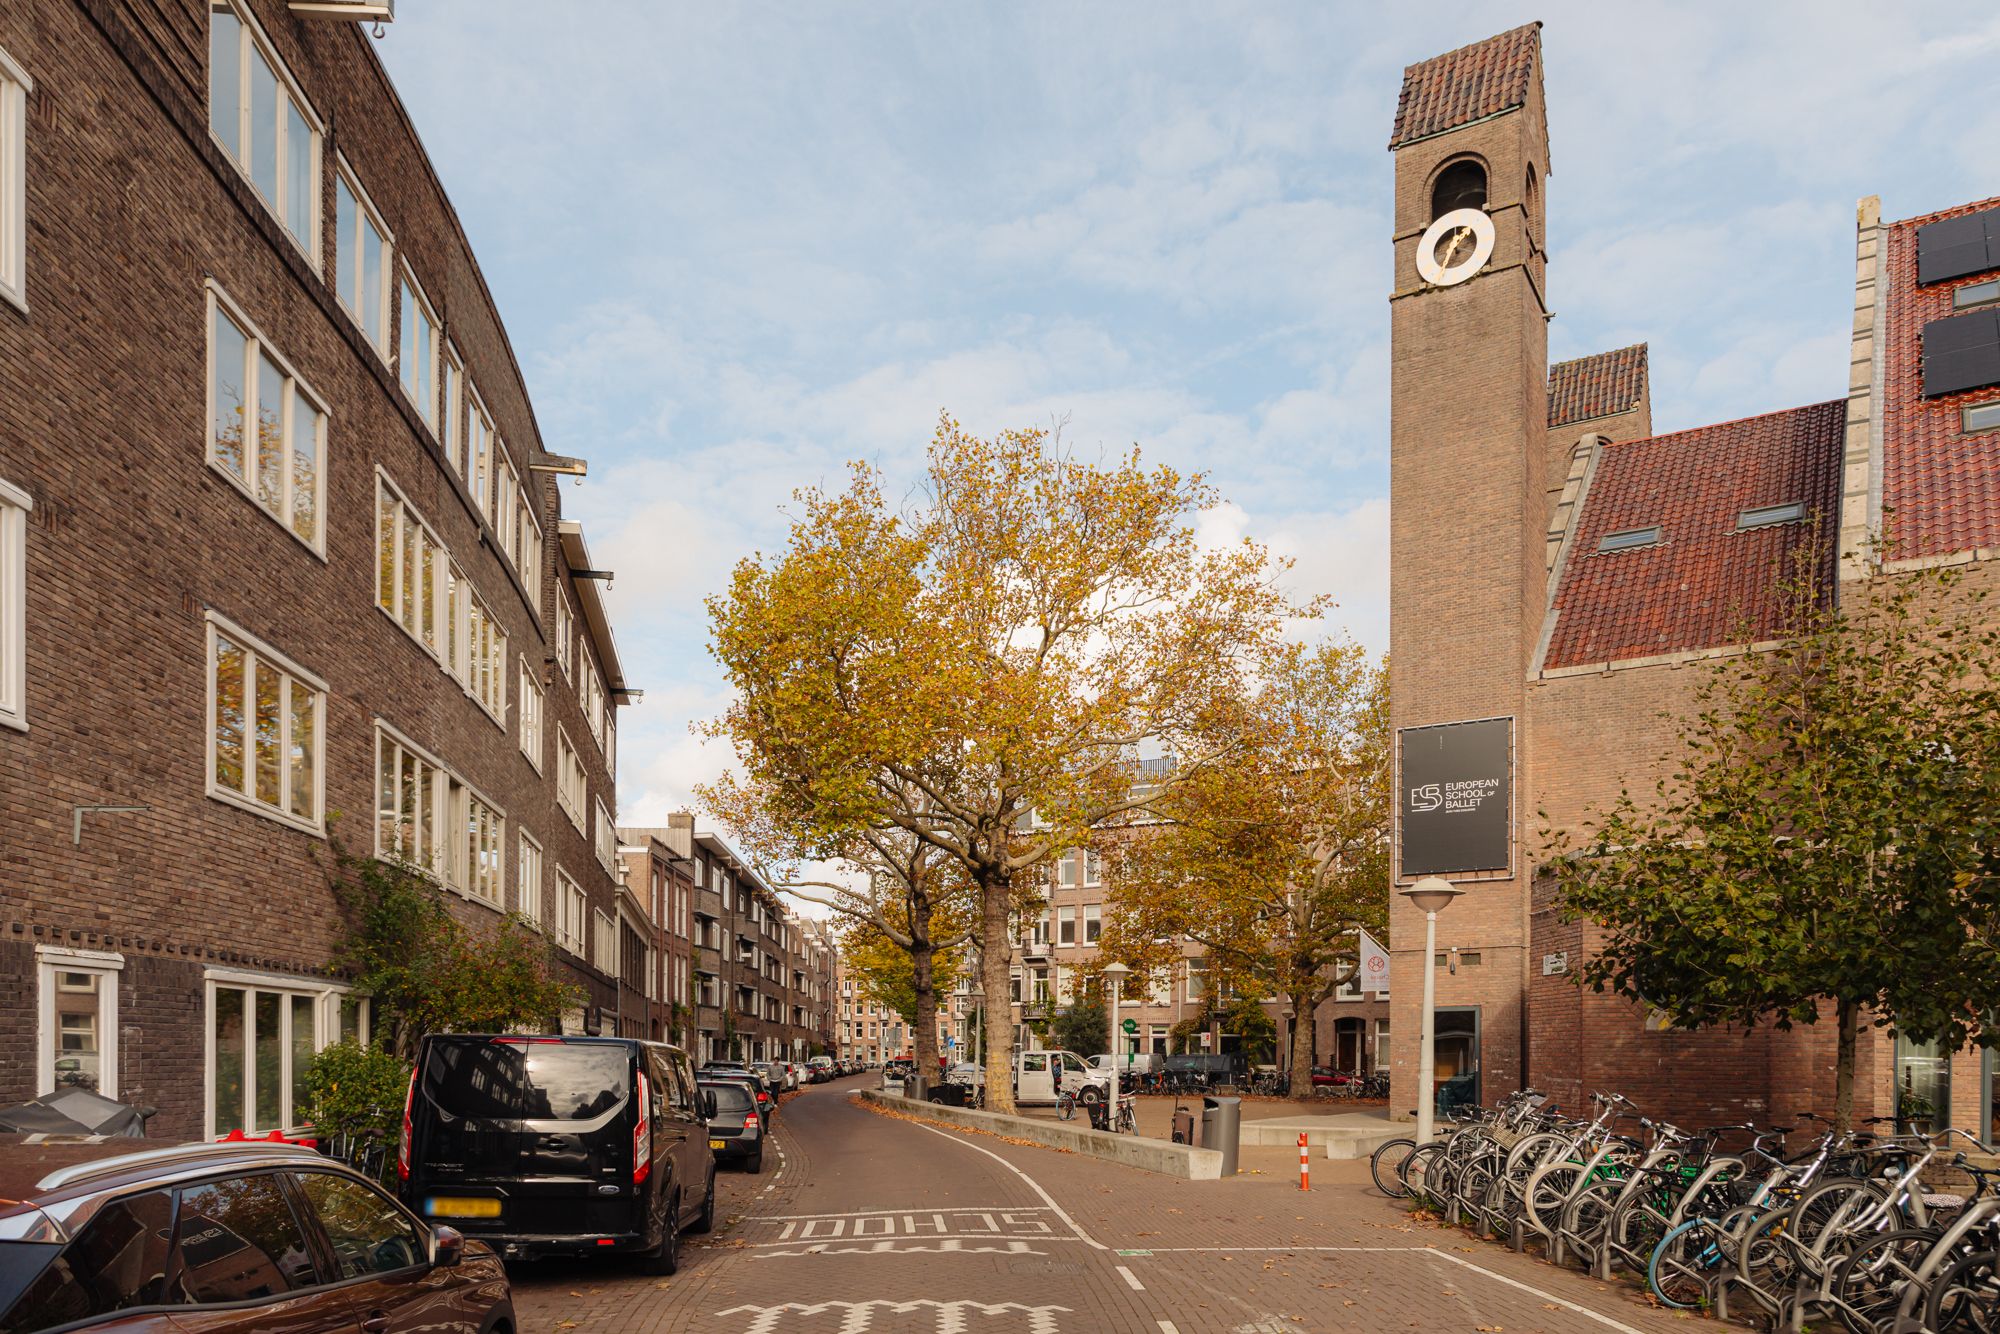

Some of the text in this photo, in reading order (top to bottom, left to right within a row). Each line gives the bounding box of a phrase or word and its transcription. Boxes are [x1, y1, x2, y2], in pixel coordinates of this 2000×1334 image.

[1445, 778, 1499, 791] EUROPEAN
[1445, 789, 1487, 800] SCHOOL
[1445, 798, 1482, 809] BALLET
[759, 1212, 1053, 1241] SCHOOL
